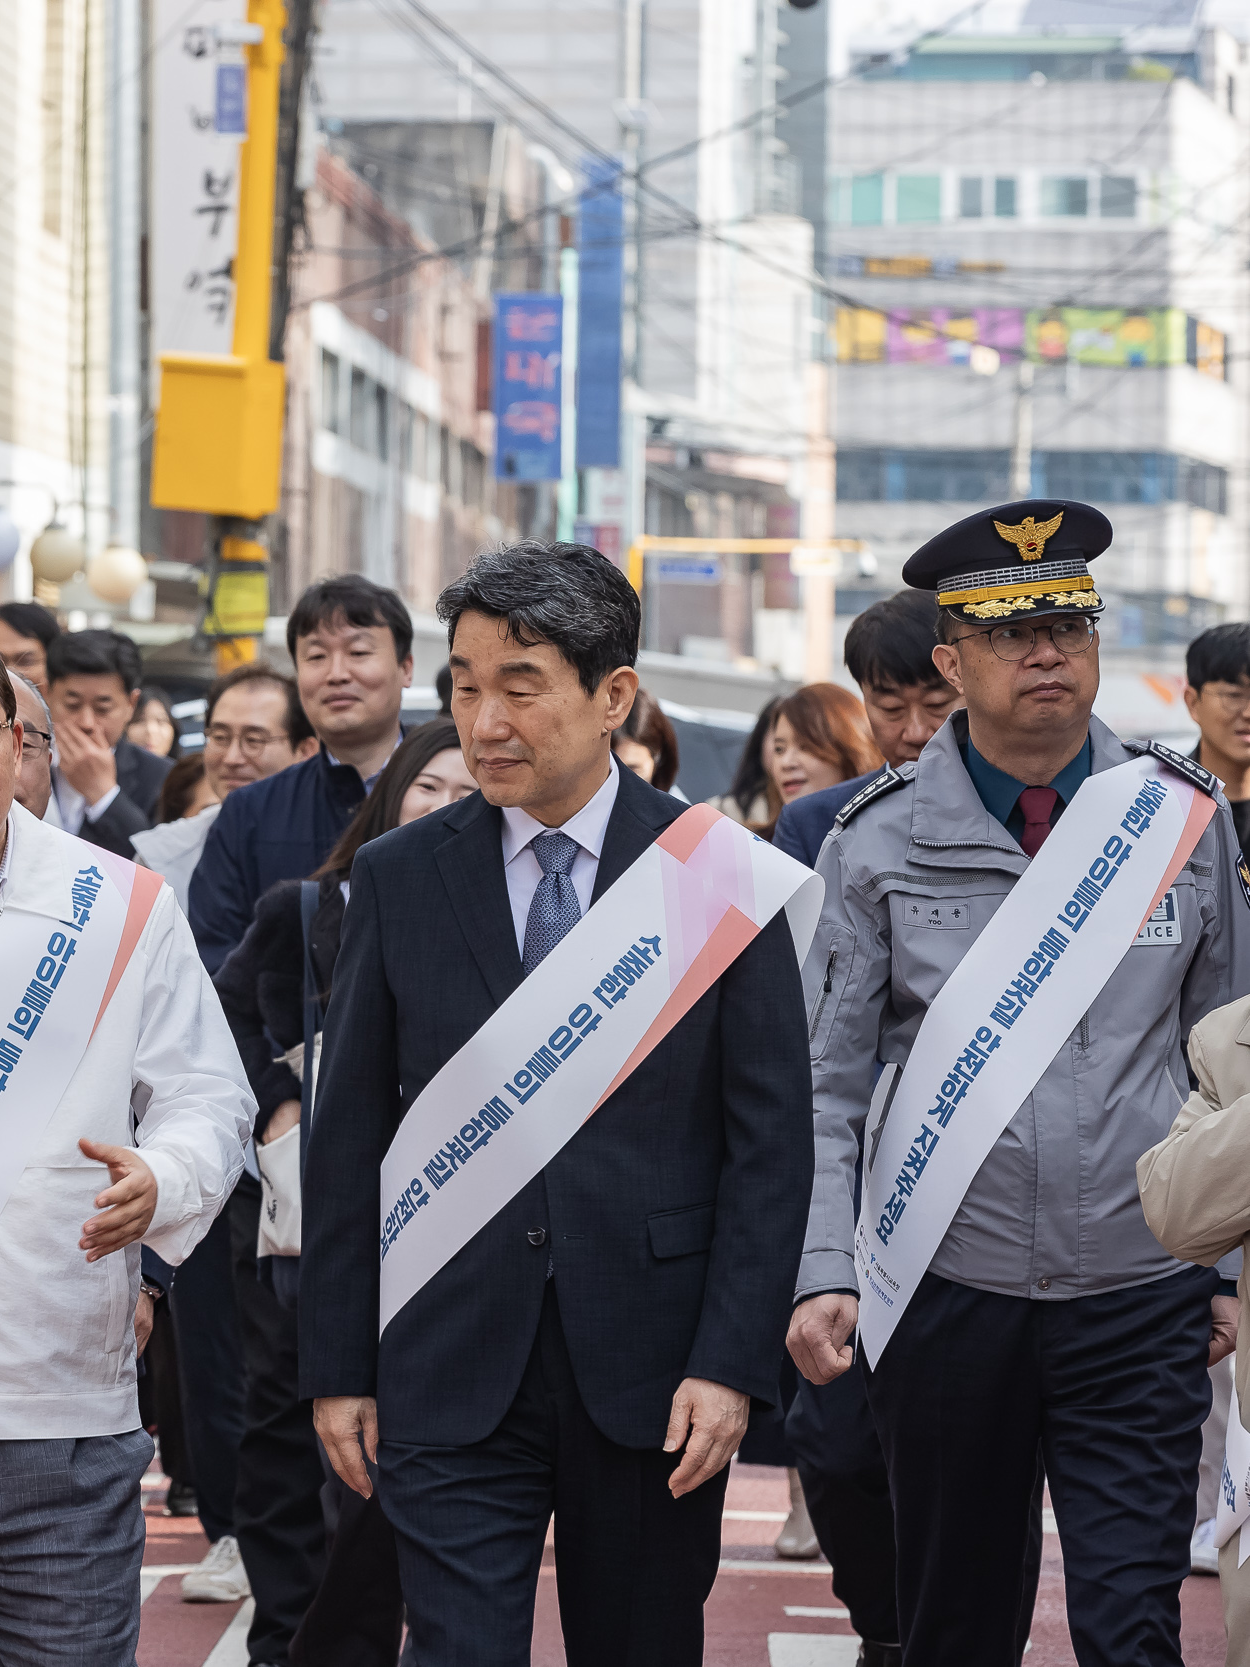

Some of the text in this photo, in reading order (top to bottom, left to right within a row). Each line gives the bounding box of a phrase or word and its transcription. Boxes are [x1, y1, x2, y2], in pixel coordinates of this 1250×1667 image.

[59, 865, 104, 933] 소중한
[928, 918, 943, 926] YOO
[1137, 925, 1174, 938] LICE
[8, 932, 77, 1041] 아이들의
[592, 935, 662, 1010] 소중한
[875, 778, 1168, 1247] 소중한 아이들의 등하굣길 안전하게 지켜주세요
[503, 1003, 603, 1105] 아이들의
[426, 1095, 514, 1191] 등하굣길
